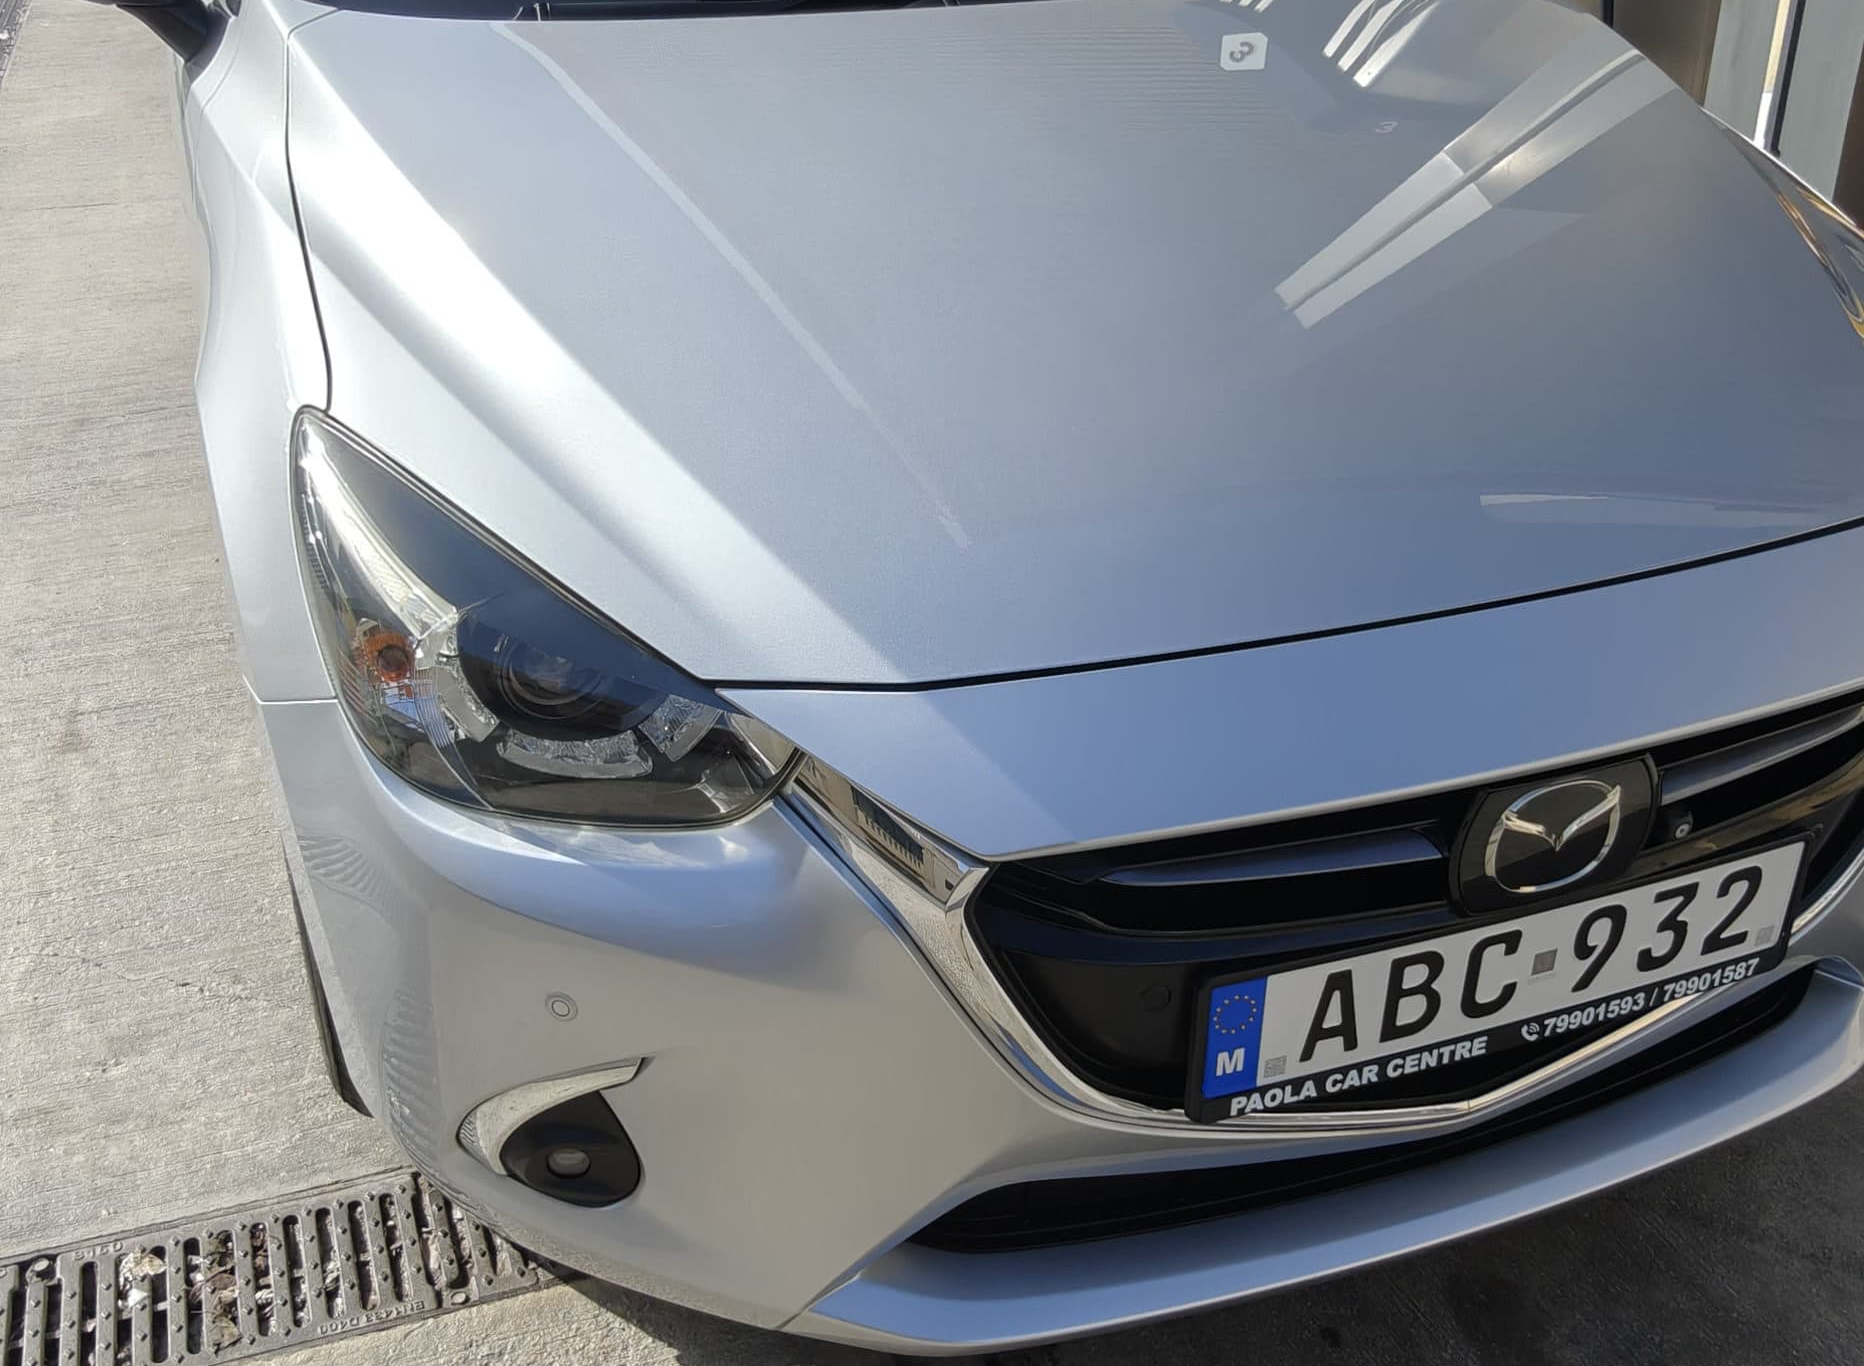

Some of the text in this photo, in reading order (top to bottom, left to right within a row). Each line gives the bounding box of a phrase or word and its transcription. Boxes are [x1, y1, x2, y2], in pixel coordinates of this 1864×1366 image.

[1298, 865, 1763, 1064] ABC 932
[1215, 1047, 1246, 1077] M
[1229, 1083, 1318, 1117] PAOLA
[1325, 1064, 1380, 1094] CAR
[1386, 1035, 1488, 1079] CENTRE
[1542, 991, 1645, 1037] 79901593
[1663, 957, 1760, 1002] 79901587
[319, 1316, 360, 1335] D400
